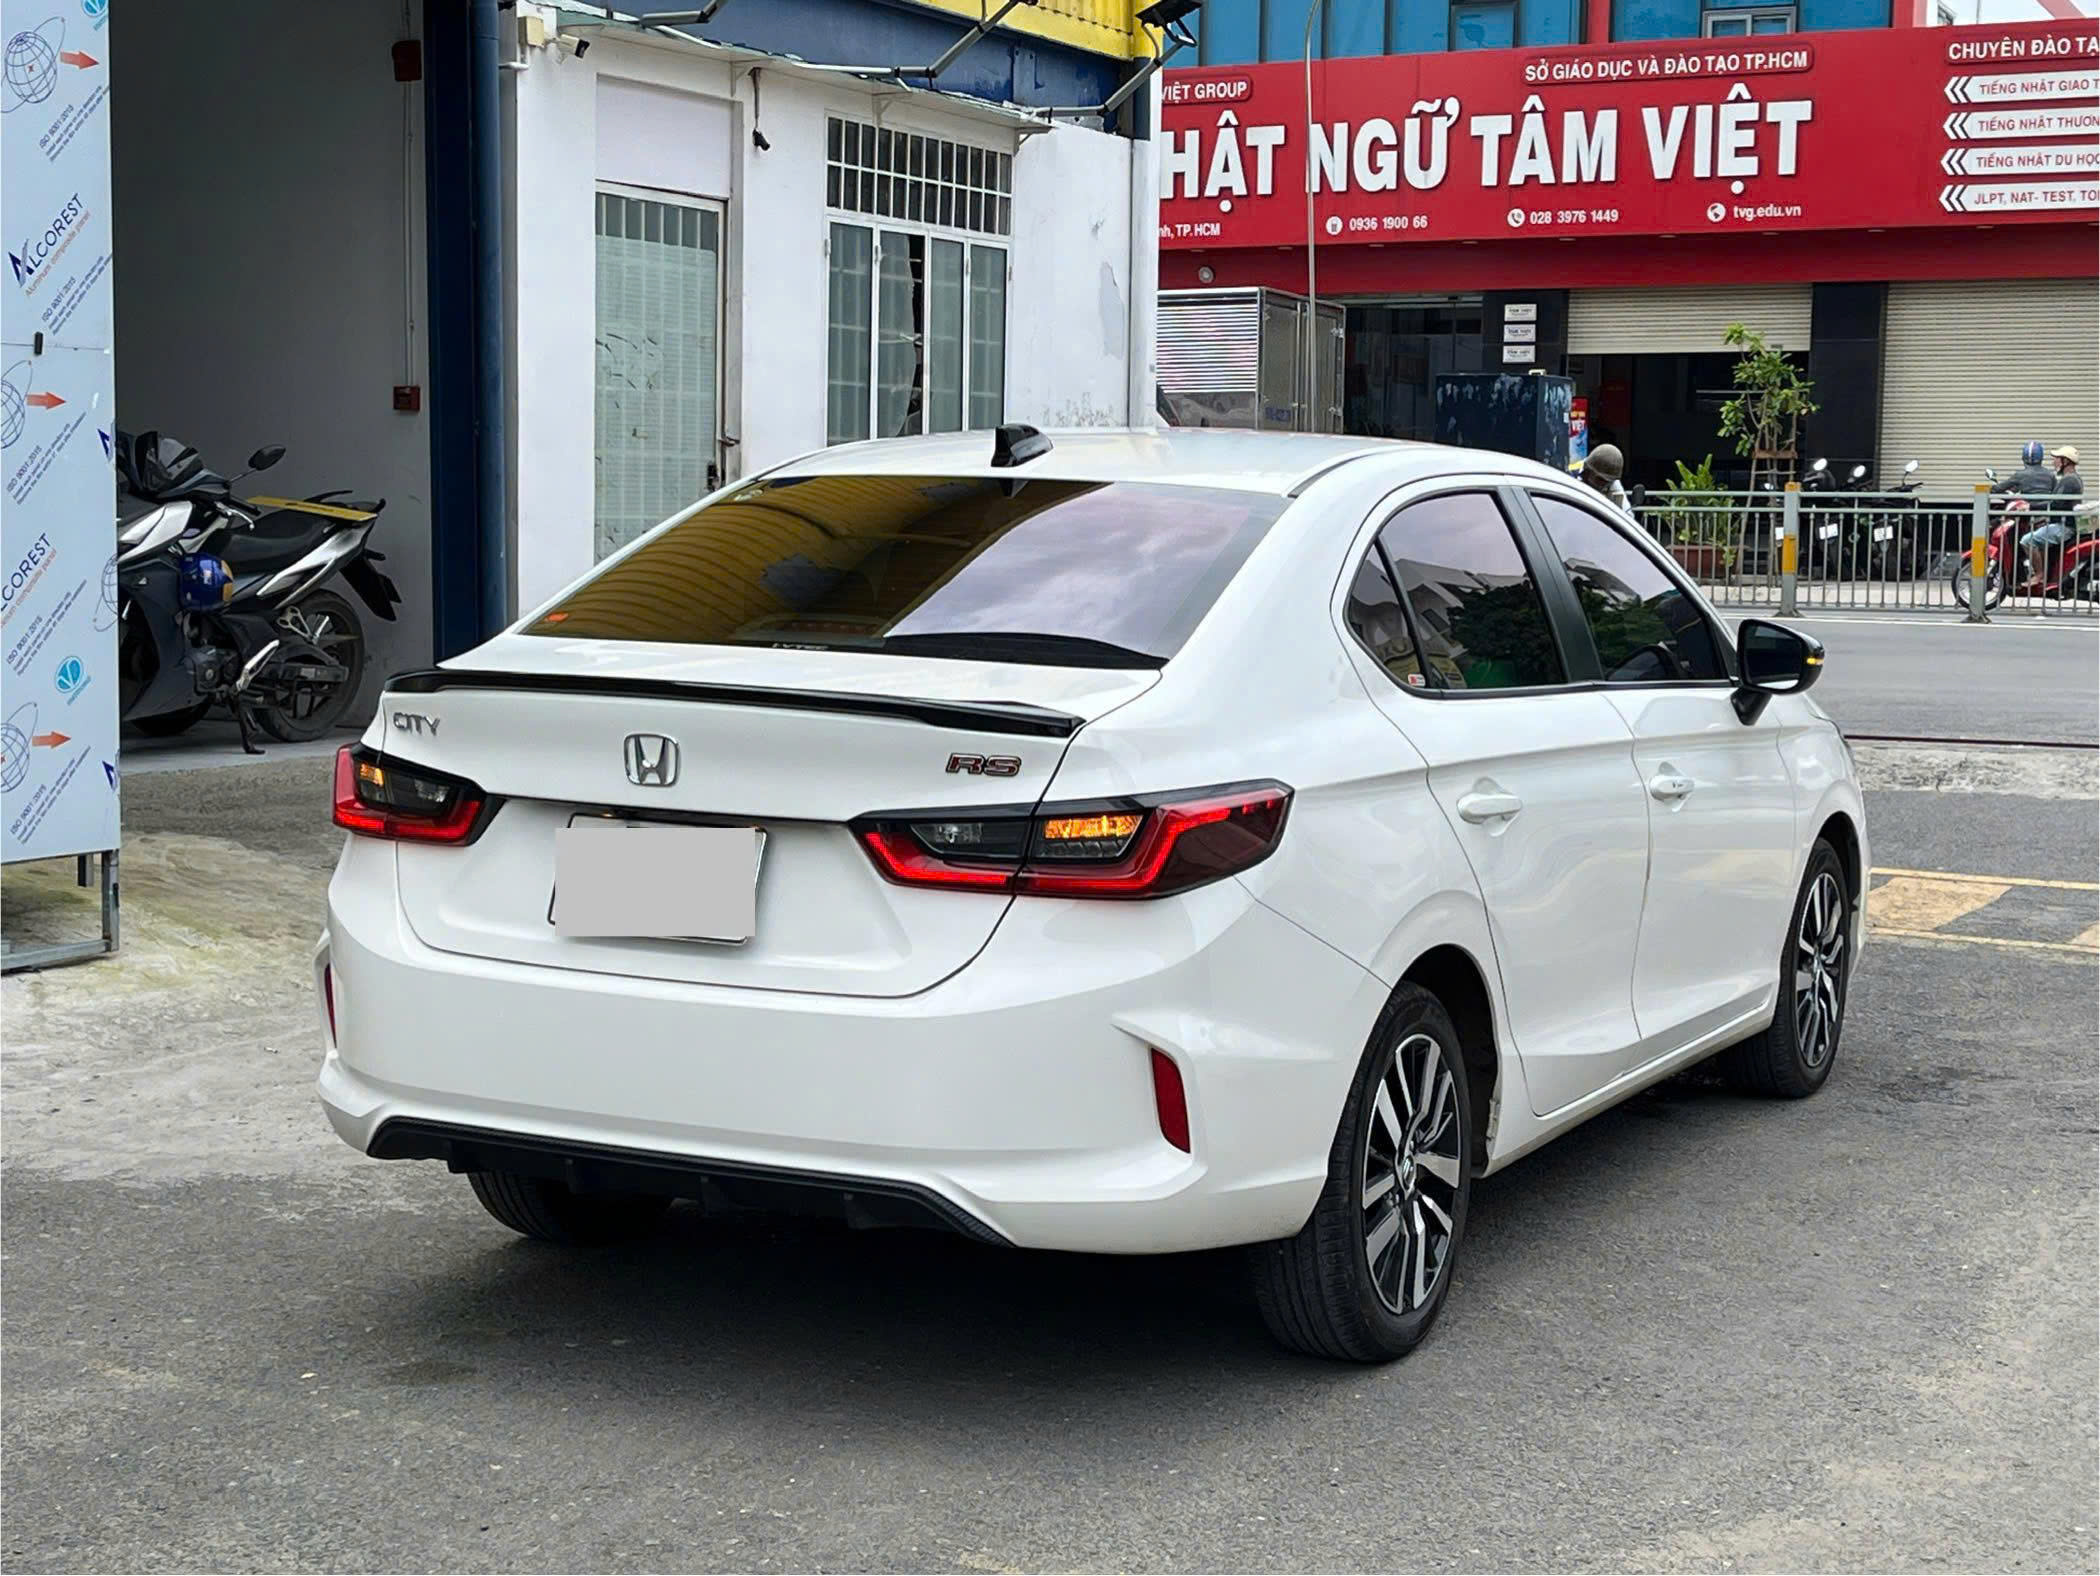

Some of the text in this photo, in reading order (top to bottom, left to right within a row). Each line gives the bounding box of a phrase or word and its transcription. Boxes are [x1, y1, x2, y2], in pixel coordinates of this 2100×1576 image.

[1948, 36, 2026, 60] CHUYÊN
[2031, 34, 2071, 56] ĐÀO
[1525, 51, 1807, 81] SỞ GIÁO DỤC VÀ ĐÀO TẠO TP.HCM
[1194, 81, 1247, 99] GROUP
[1980, 80, 2017, 95] TIẾNG
[2058, 79, 2090, 92] GIAO
[1978, 116, 2015, 131] TIẾNG
[1159, 82, 1813, 214] HẬT NGỮ TÂM VIỆT
[1976, 153, 2014, 168] TIẾNG
[2055, 154, 2073, 166] DU
[1530, 208, 1619, 225] 028 3976 1449
[1733, 199, 1802, 222] tvg.edu.vn
[1175, 223, 1221, 237] TP.HCM
[1349, 215, 1428, 231] 0936 1900 66
[8, 192, 83, 289] ALCOREST
[393, 711, 441, 736] CITY
[945, 752, 1022, 777] RS
